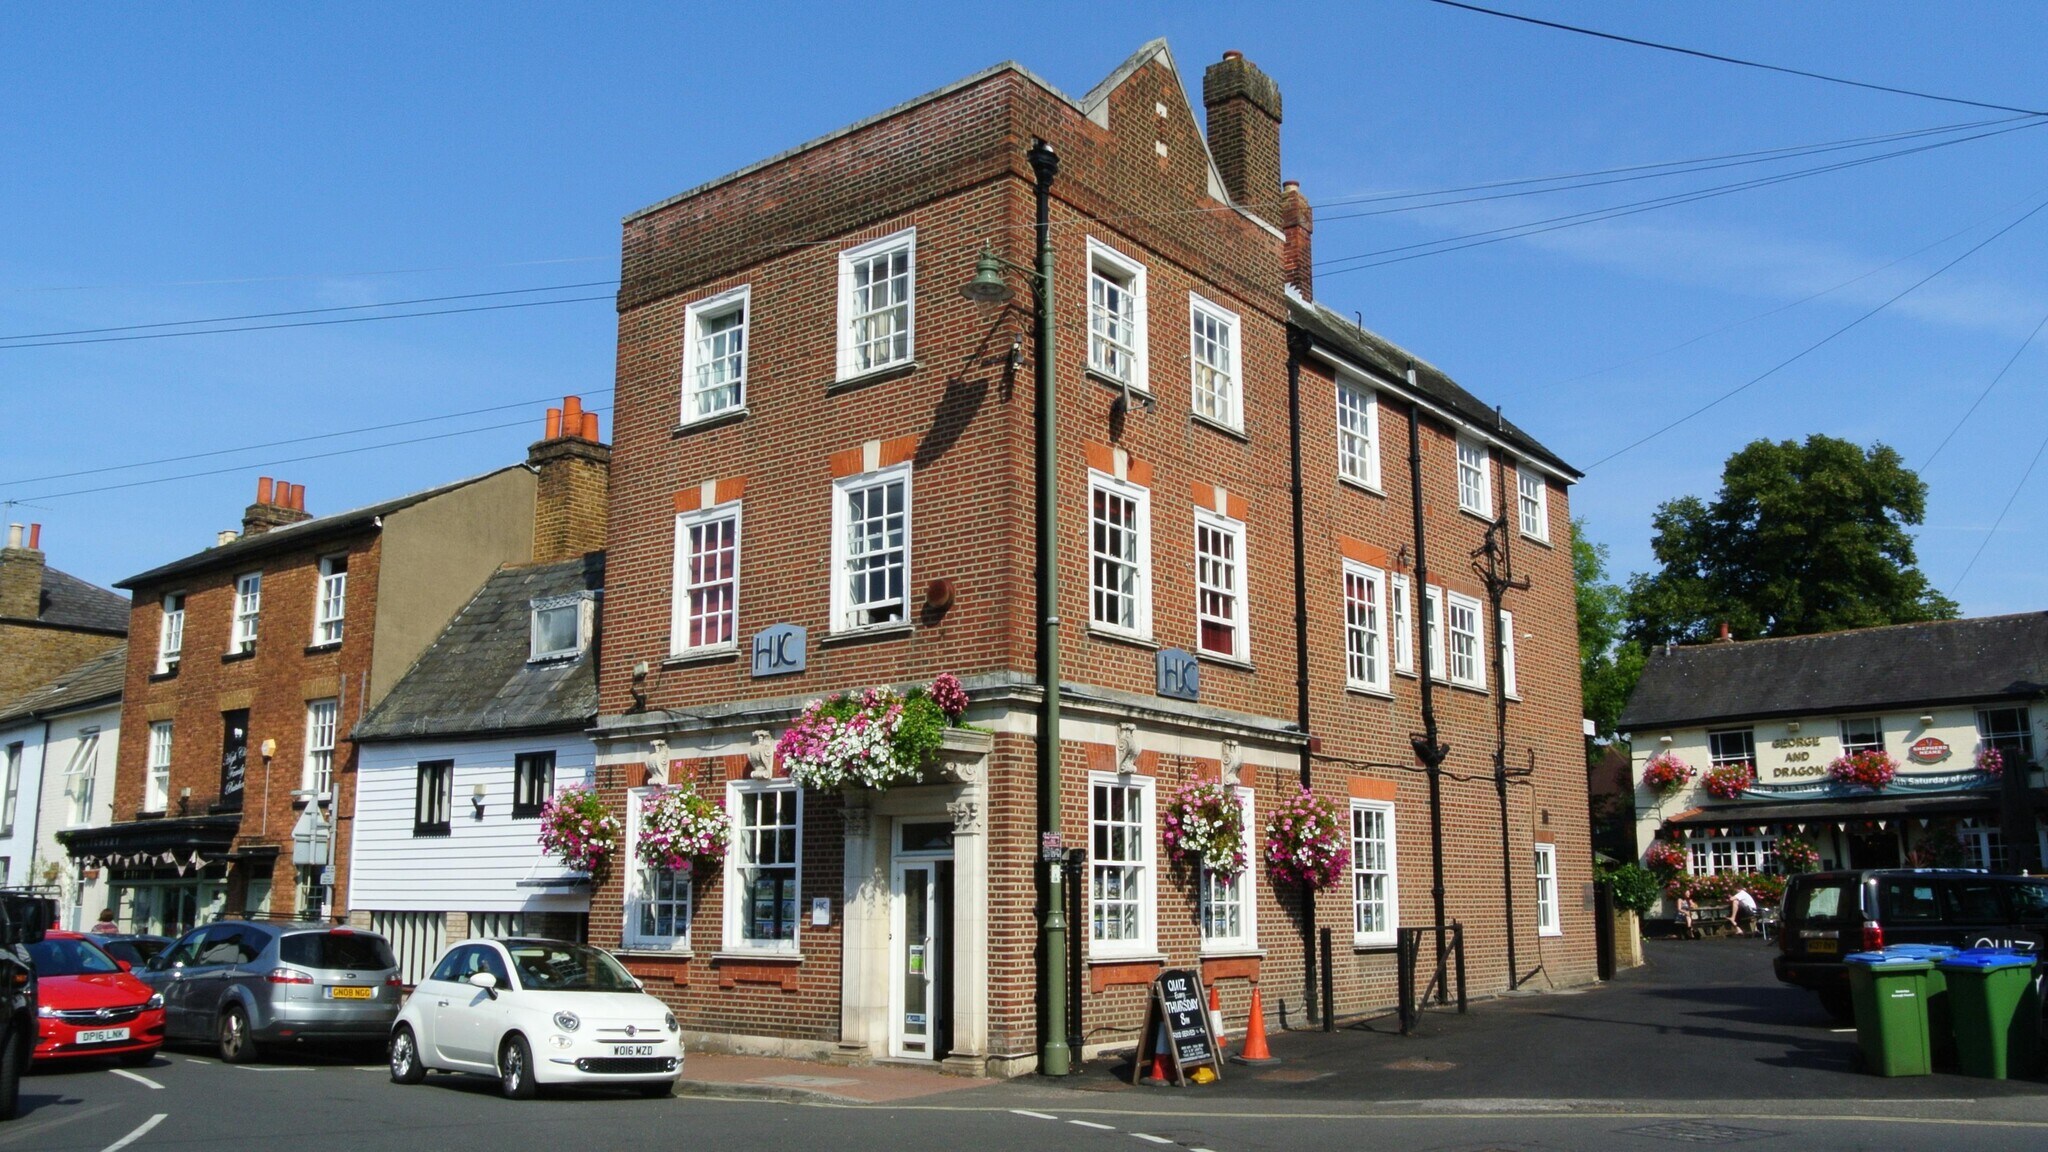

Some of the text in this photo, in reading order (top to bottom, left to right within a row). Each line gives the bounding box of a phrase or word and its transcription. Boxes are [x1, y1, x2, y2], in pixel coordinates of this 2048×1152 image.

[755, 632, 797, 670] HJC
[1164, 656, 1197, 694] HJC
[1772, 736, 1821, 749] GEORGE
[1785, 752, 1810, 763] AND
[1773, 766, 1826, 778] DRAGON
[1908, 775, 1949, 786] Saturday
[1951, 775, 1960, 783] of
[1778, 783, 1832, 794] MARKET
[1167, 978, 1187, 992] QUIZ
[333, 988, 354, 997] GN08
[1166, 998, 1199, 1014] THURSDAY
[83, 1029, 125, 1042] DP16 LNK
[635, 1045, 653, 1055] MZD
